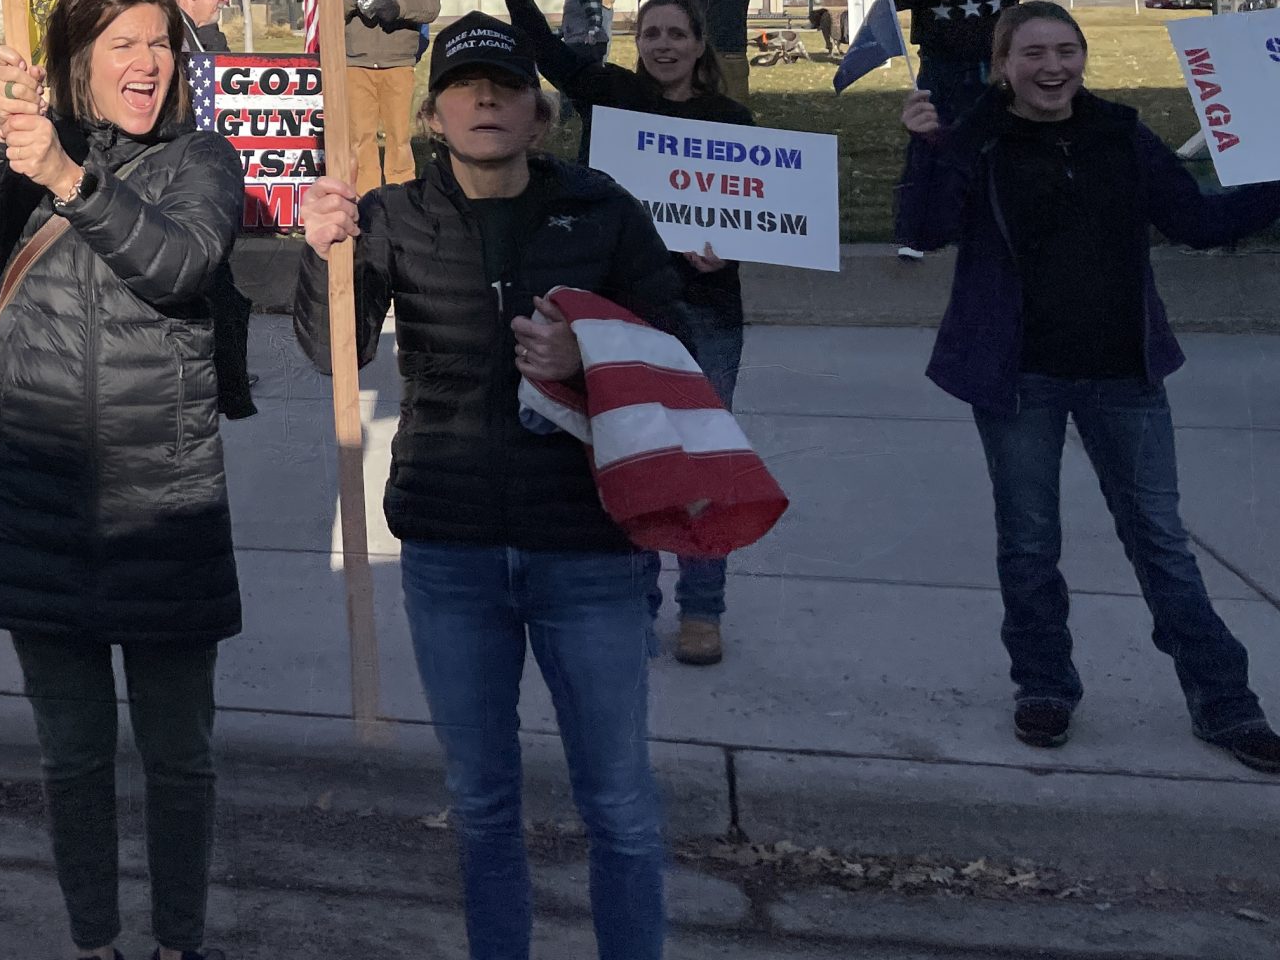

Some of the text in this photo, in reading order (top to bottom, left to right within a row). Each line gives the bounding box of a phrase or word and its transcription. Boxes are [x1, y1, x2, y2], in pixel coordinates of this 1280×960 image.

[445, 28, 517, 50] MAKE AMERICA
[446, 40, 513, 58] GREAT AGAIN
[220, 67, 323, 96] GOD
[1184, 47, 1240, 153] MAGA
[217, 109, 324, 137] GUNS
[637, 130, 802, 170] FREEDOM
[669, 168, 765, 199] OVER
[641, 199, 808, 237] MMUNISM
